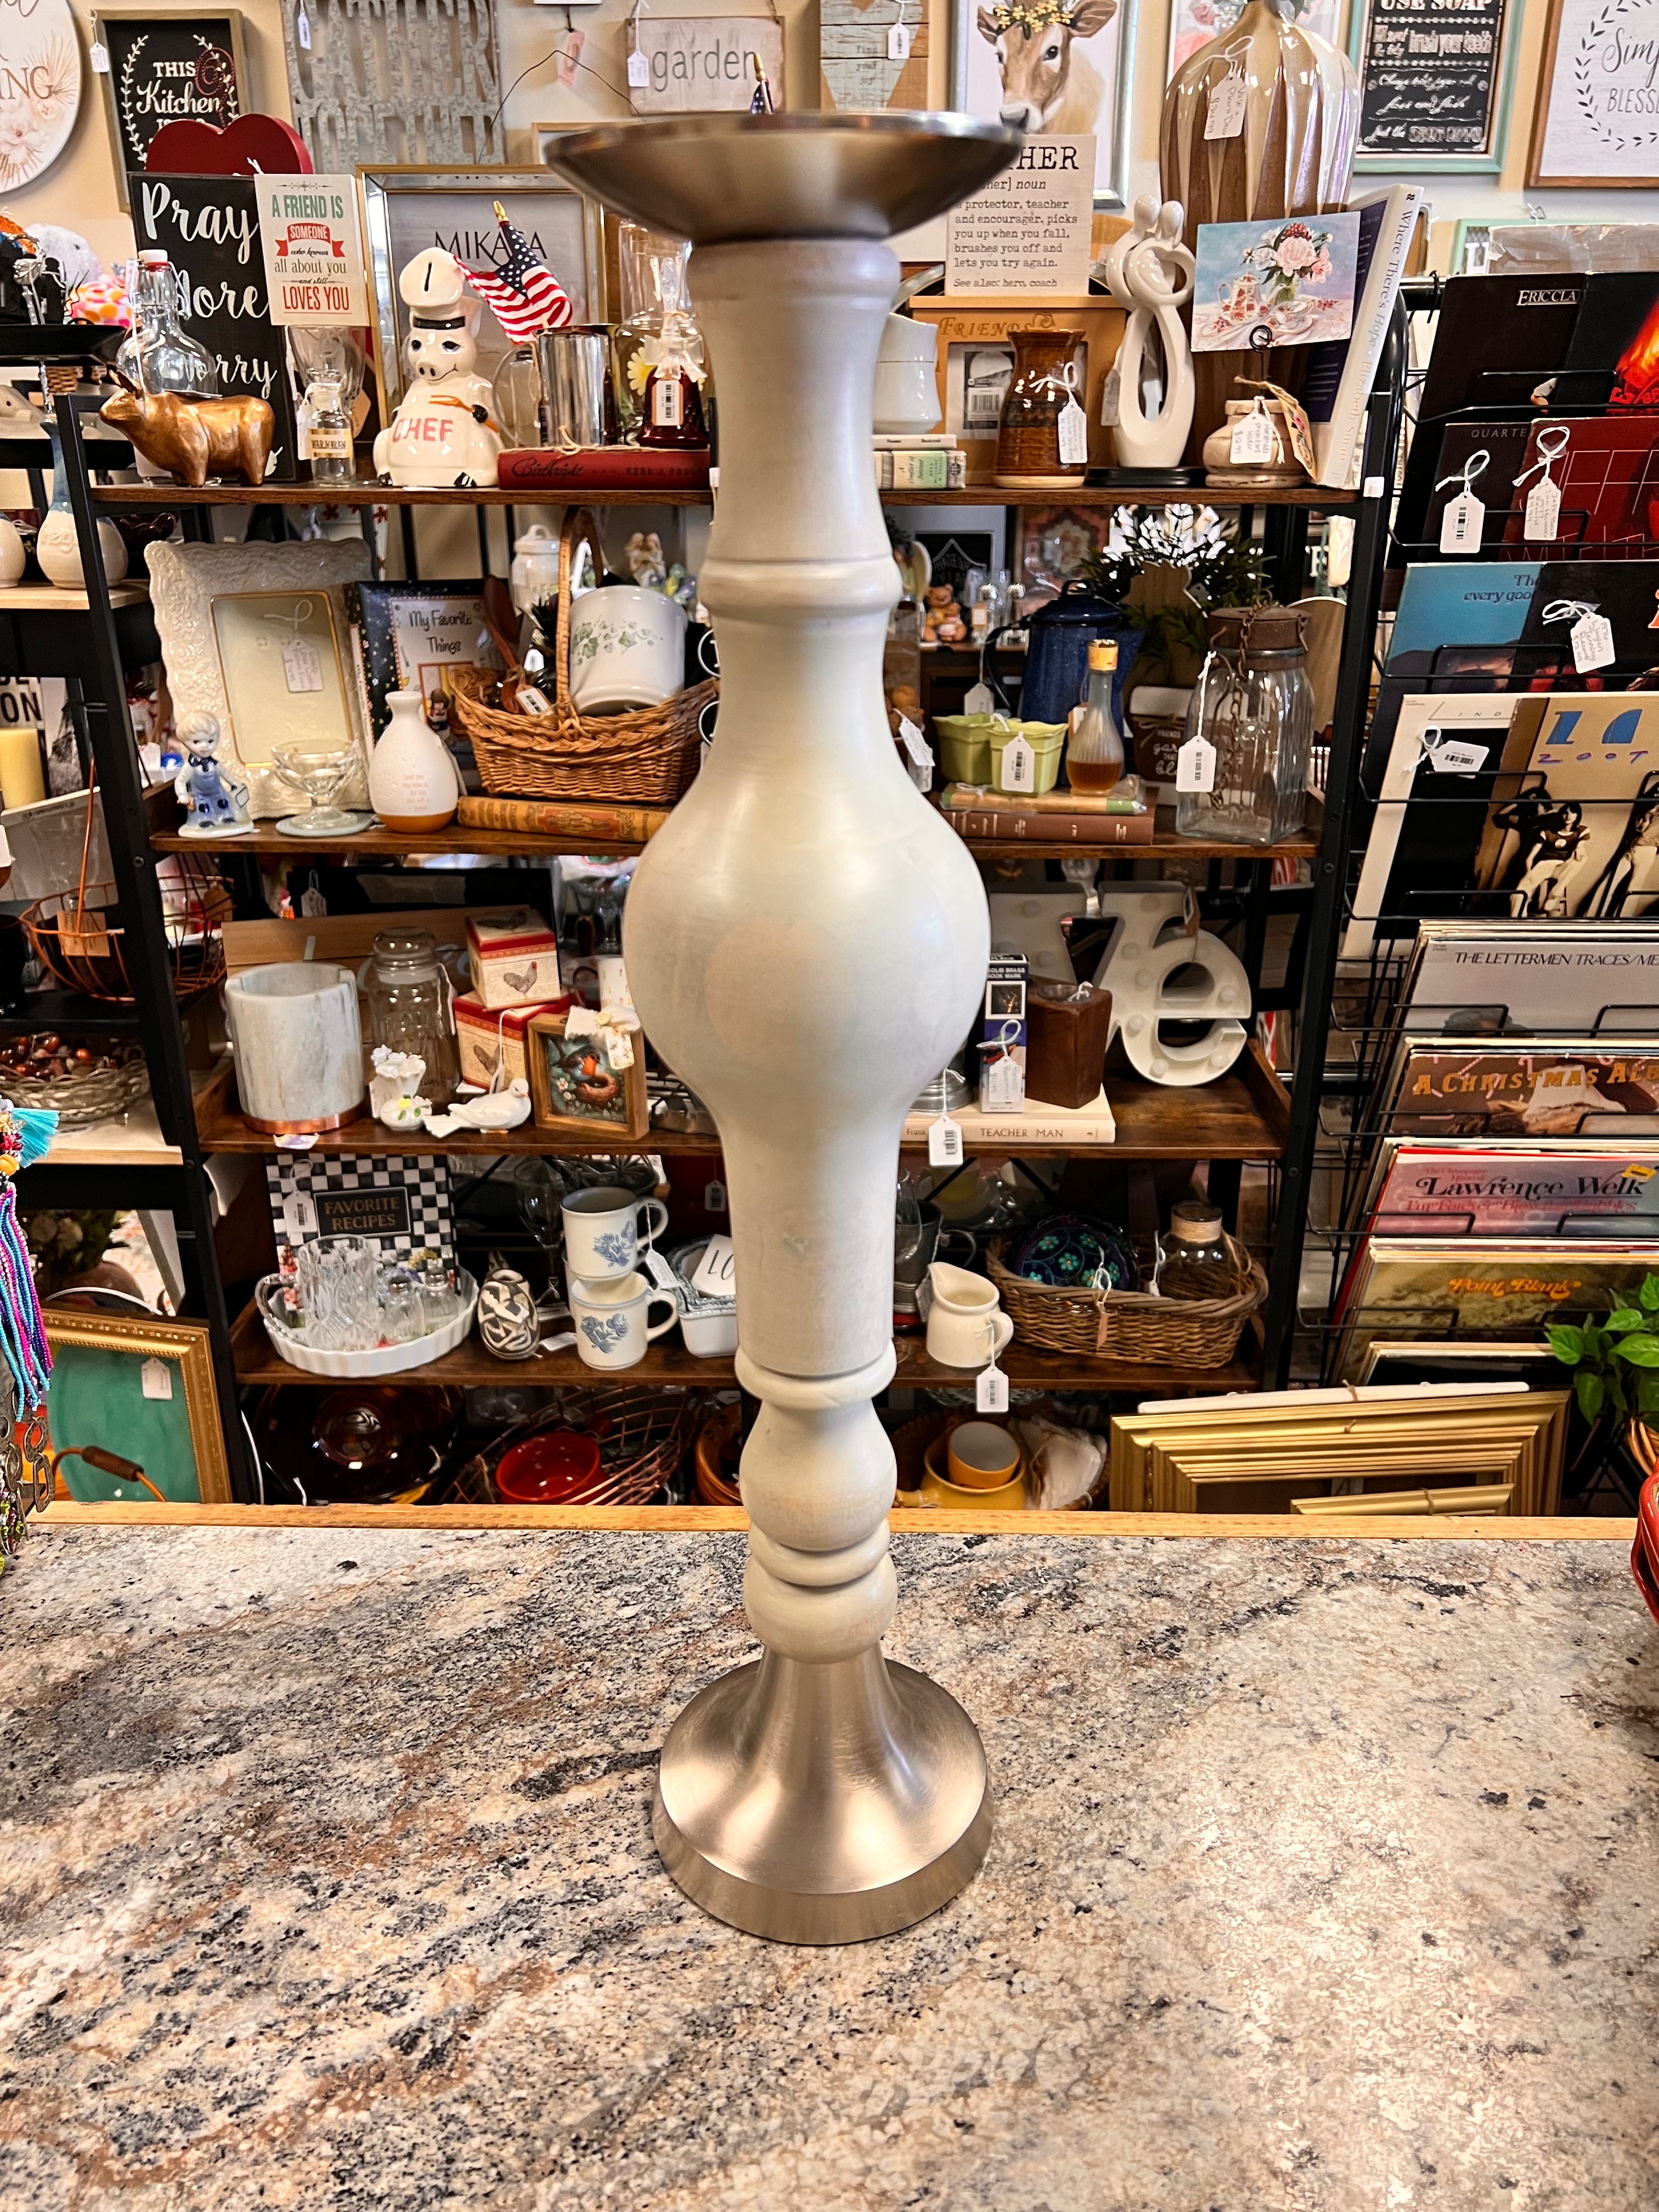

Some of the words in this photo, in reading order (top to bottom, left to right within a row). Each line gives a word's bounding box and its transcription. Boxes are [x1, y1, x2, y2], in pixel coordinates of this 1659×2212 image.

[153, 61, 196, 77] THIS
[652, 38, 757, 92] garden
[0, 66, 54, 100] NG
[136, 79, 221, 114] Kitchen
[1607, 88, 1659, 114] BLESS
[1005, 146, 1079, 170] HER
[1015, 180, 1046, 190] noun
[272, 194, 281, 218] A
[283, 194, 328, 218] FRIEND
[331, 195, 344, 219] IS
[965, 199, 1023, 211] protector,
[1025, 199, 1069, 209] teacher
[142, 182, 259, 264] Pray
[955, 214, 975, 224] and
[1047, 213, 1077, 225] picks
[290, 224, 328, 239] SOMEONE
[954, 230, 973, 240] you
[977, 230, 989, 240] up
[992, 229, 1018, 238] when
[1020, 230, 1039, 240] you
[1392, 210, 1413, 255] Where
[435, 231, 548, 267] MIKAA
[954, 244, 998, 253] brushes
[1000, 245, 1019, 255] you
[1022, 244, 1040, 253] off
[1043, 244, 1062, 253] and
[274, 258, 287, 273] all
[291, 259, 323, 273] about
[326, 262, 346, 276] you
[953, 258, 977, 267] lets
[979, 259, 998, 269] you
[1001, 259, 1020, 269] try
[953, 279, 971, 287] See
[1029, 279, 1057, 287] coach
[1378, 258, 1401, 308] There's
[283, 286, 320, 310] LOVES
[323, 286, 349, 311] YOU
[1516, 290, 1551, 306] ERIC
[1551, 290, 1571, 303] CLA
[393, 417, 454, 443] CHEF
[1471, 427, 1532, 439] QUARTE
[1464, 592, 1504, 605] every
[1506, 592, 1532, 603] goo
[409, 610, 430, 631] My
[431, 610, 472, 627] Favorite
[426, 636, 461, 655] Things
[1455, 952, 1483, 964] THE
[1485, 952, 1572, 966] LETTERMEN
[1413, 1074, 1432, 1096] A
[1441, 1066, 1599, 1093] CHRISTMAS
[980, 1127, 1028, 1137] TEACHER
[1036, 1128, 1064, 1137] MAN
[1415, 1175, 1564, 1201] Lawrence
[1577, 1176, 1643, 1195] Welk
[324, 1197, 400, 1215] FAVORITE
[331, 1214, 396, 1231] RECIPES
